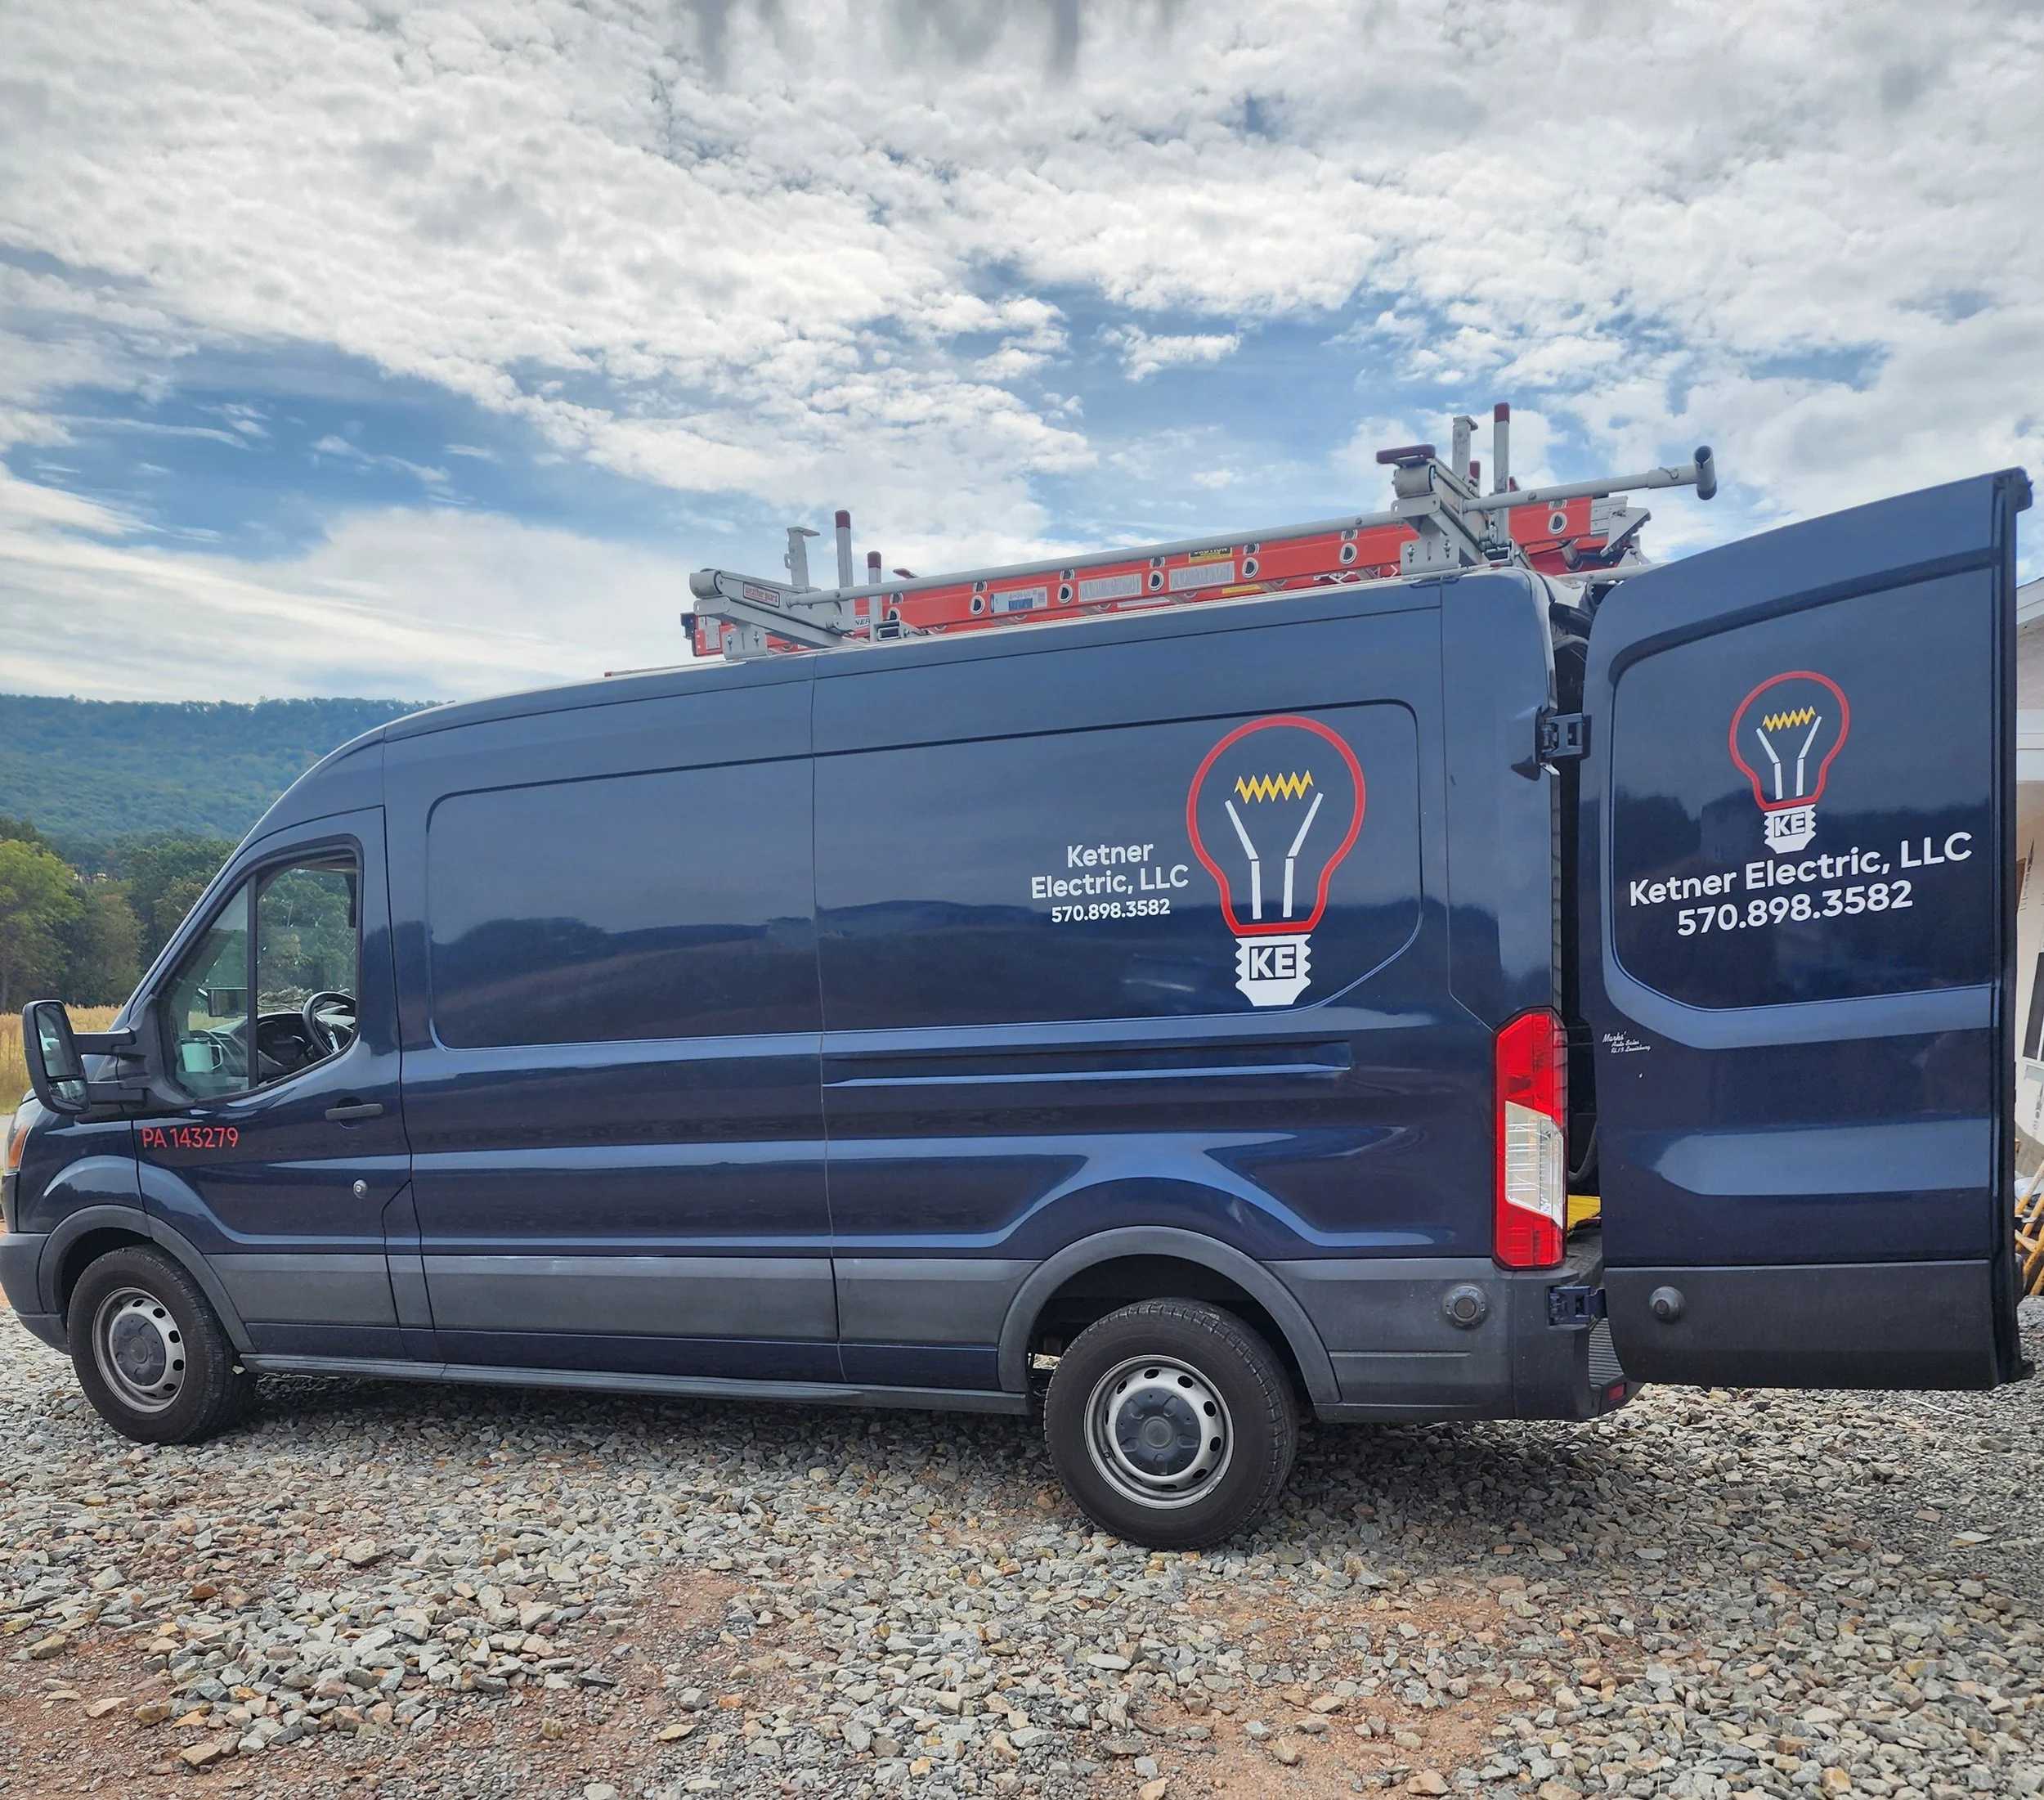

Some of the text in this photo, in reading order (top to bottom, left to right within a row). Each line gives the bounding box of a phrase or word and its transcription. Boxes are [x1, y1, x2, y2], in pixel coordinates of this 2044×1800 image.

[1775, 813, 1805, 837] KE
[1067, 843, 1154, 868] Ketner
[1629, 831, 1973, 906] Ketner Electric, LLC
[1031, 864, 1189, 899] Electric, LLC
[1051, 899, 1171, 923] 570.898.3582
[1677, 879, 1913, 936] 570.898.3582
[1251, 947, 1295, 979] KE
[141, 1127, 239, 1148] PA 143279
